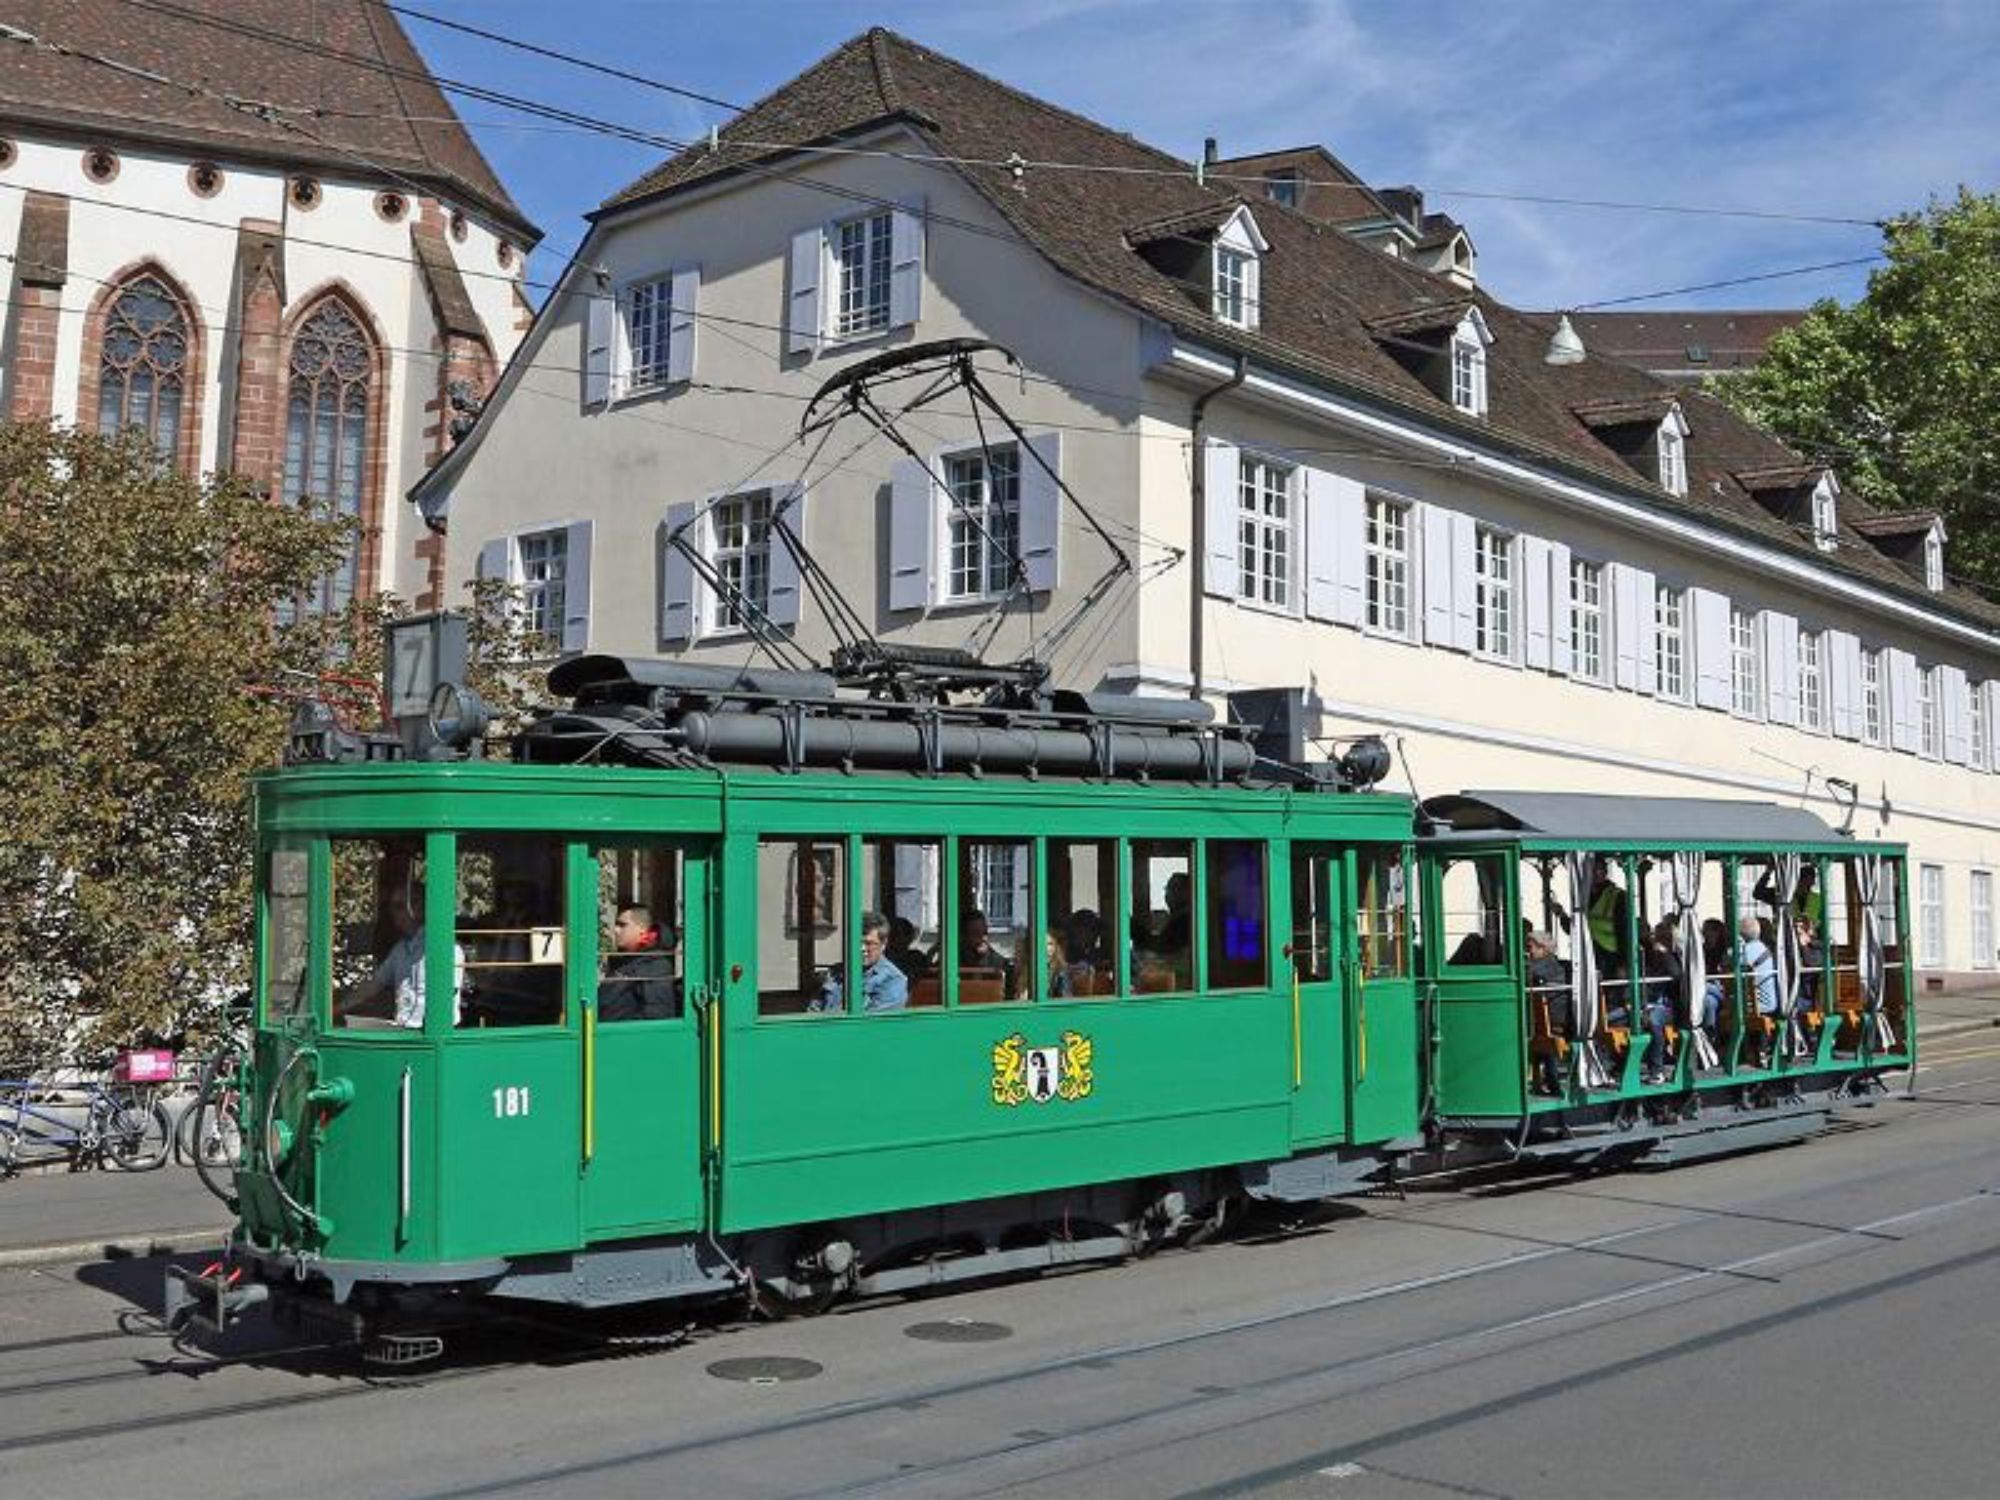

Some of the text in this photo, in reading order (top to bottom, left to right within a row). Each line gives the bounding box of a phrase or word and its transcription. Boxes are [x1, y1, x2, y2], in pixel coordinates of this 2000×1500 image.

[402, 639, 424, 699] 7
[542, 931, 553, 958] 7
[493, 1087, 529, 1118] 181
